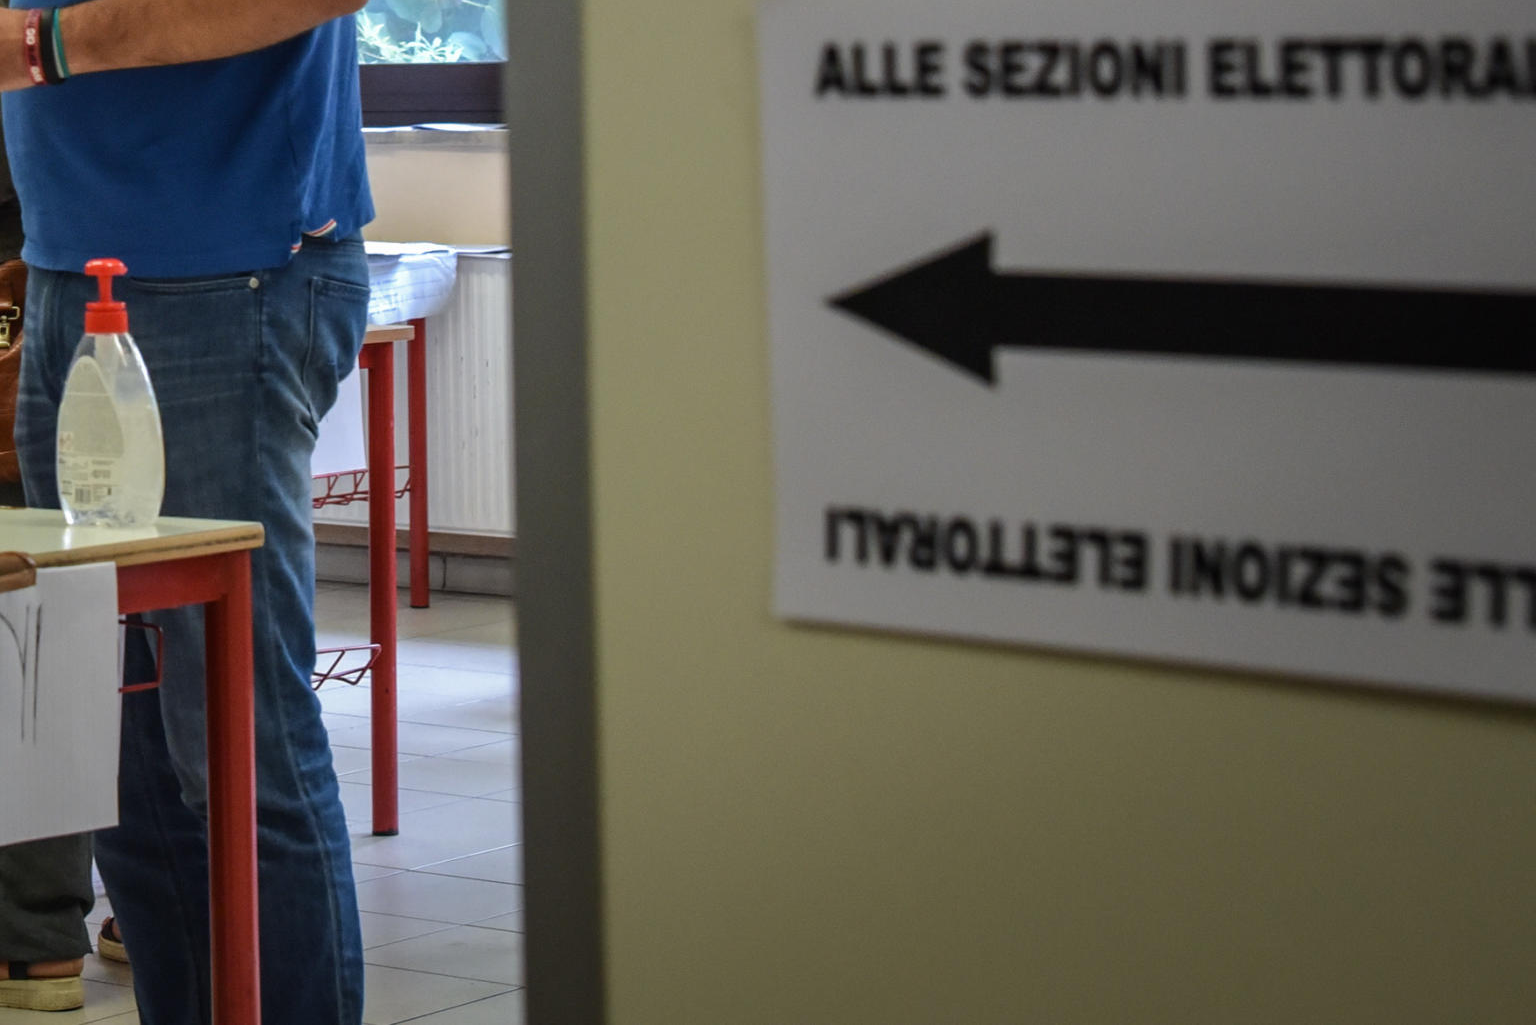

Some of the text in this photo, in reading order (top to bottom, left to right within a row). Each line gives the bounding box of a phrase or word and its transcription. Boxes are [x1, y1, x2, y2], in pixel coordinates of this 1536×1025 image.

[814, 40, 947, 100] ALLE
[962, 38, 1190, 101] SEZIONI
[824, 506, 1153, 596] ELETTORALI
[1167, 536, 1413, 621] SEZIONI
